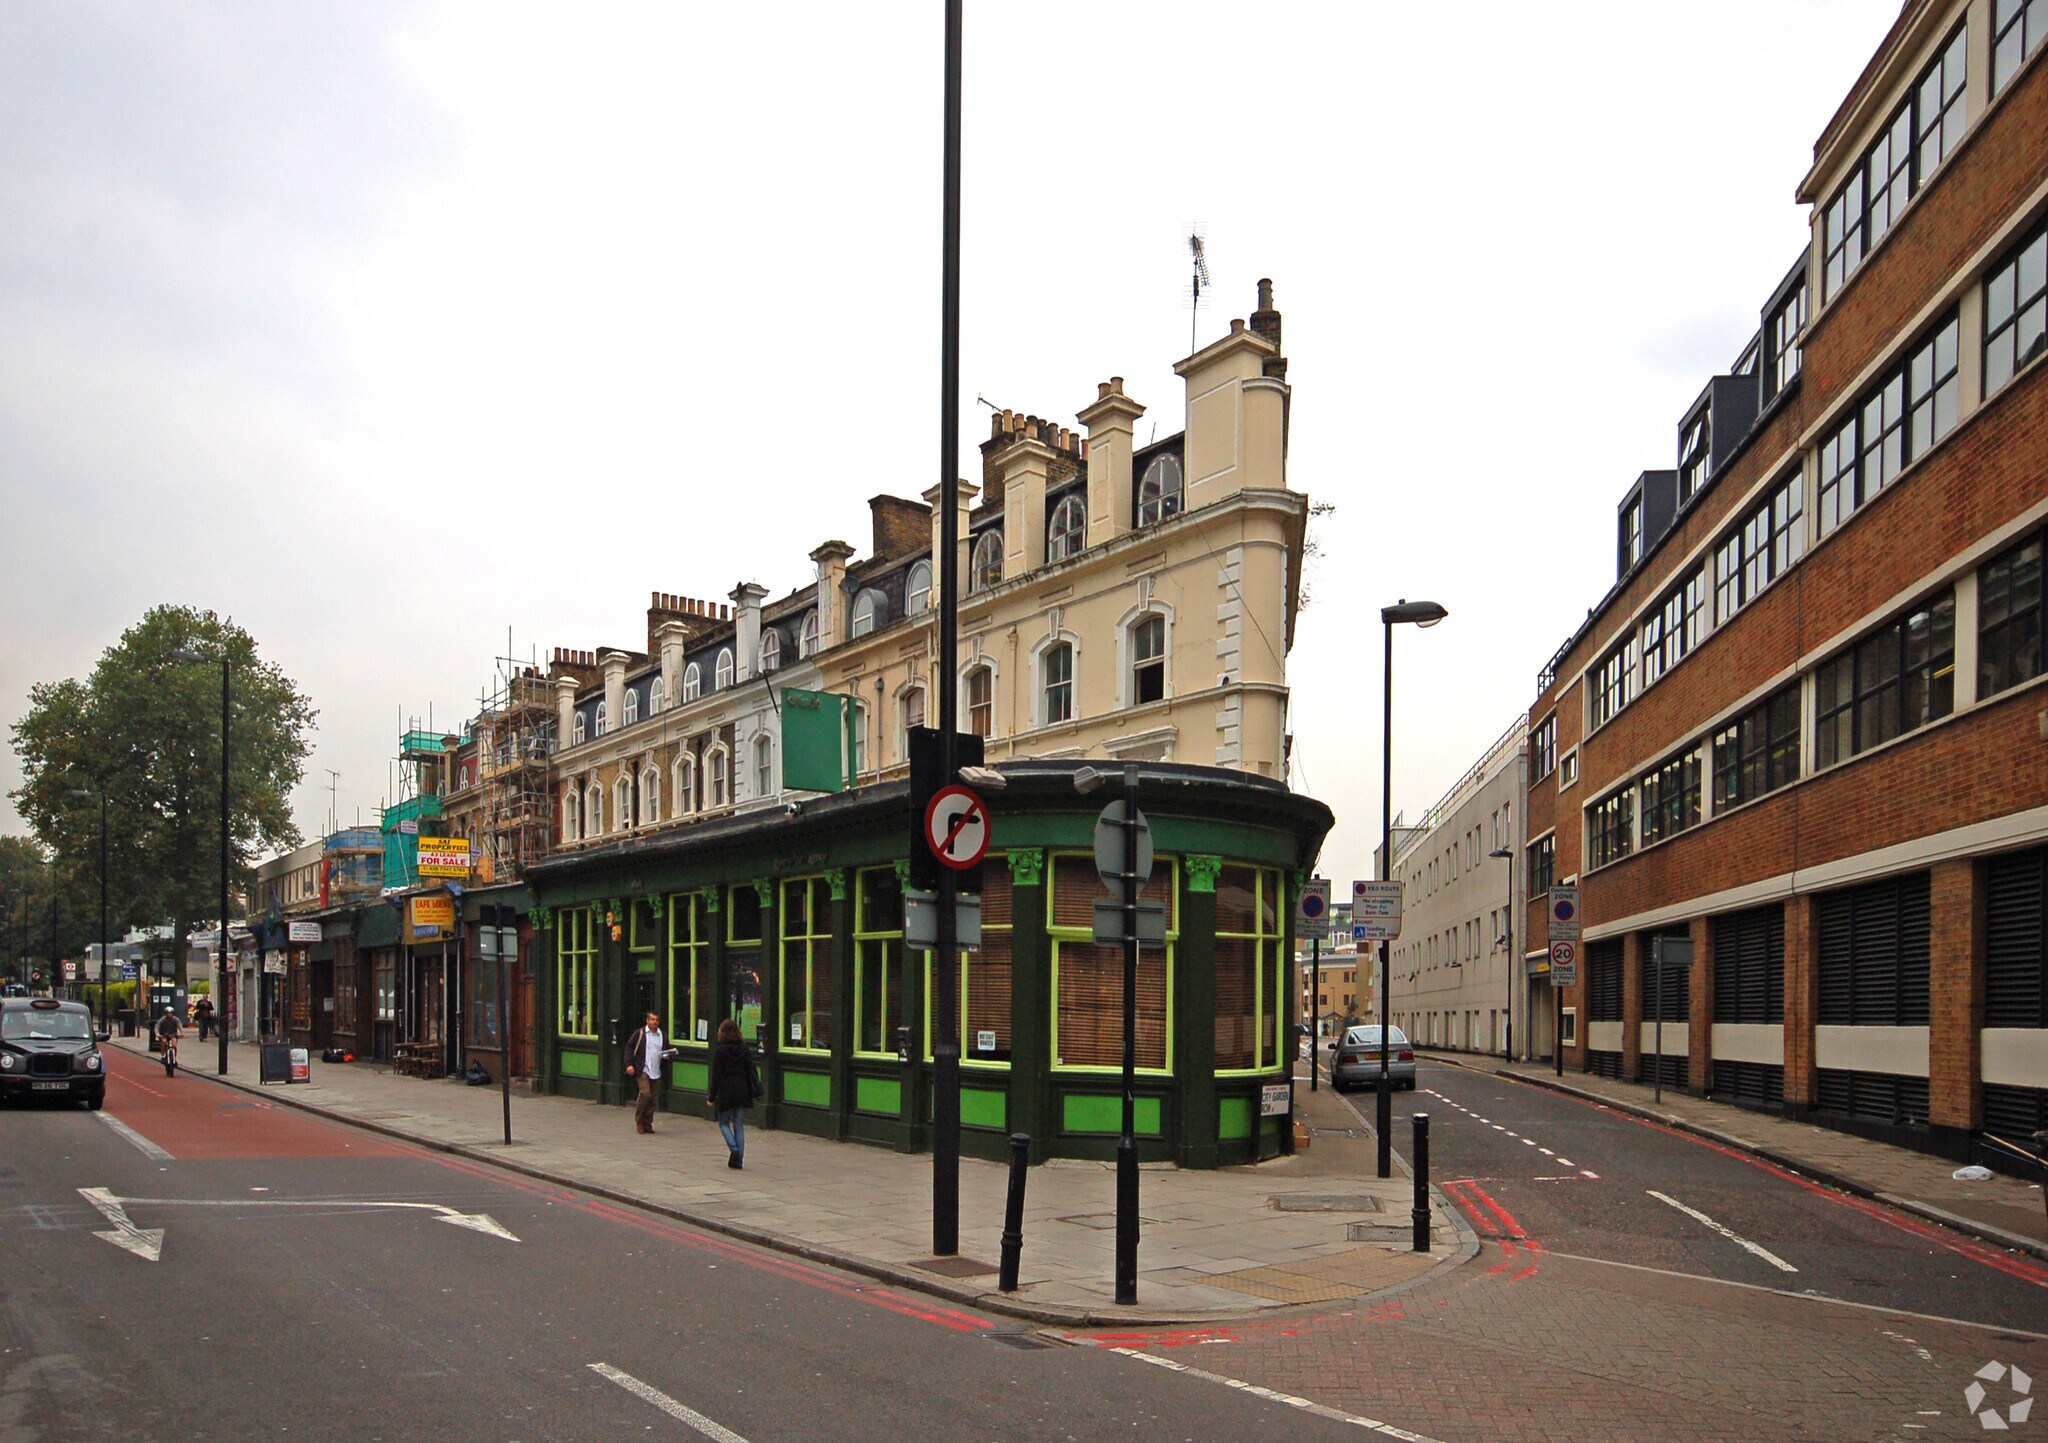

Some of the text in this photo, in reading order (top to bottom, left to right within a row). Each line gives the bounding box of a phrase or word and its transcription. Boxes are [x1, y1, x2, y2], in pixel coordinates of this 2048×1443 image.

[421, 857, 466, 866] FOR SALE
[415, 900, 430, 908] CAFE
[1555, 949, 1571, 958] 20
